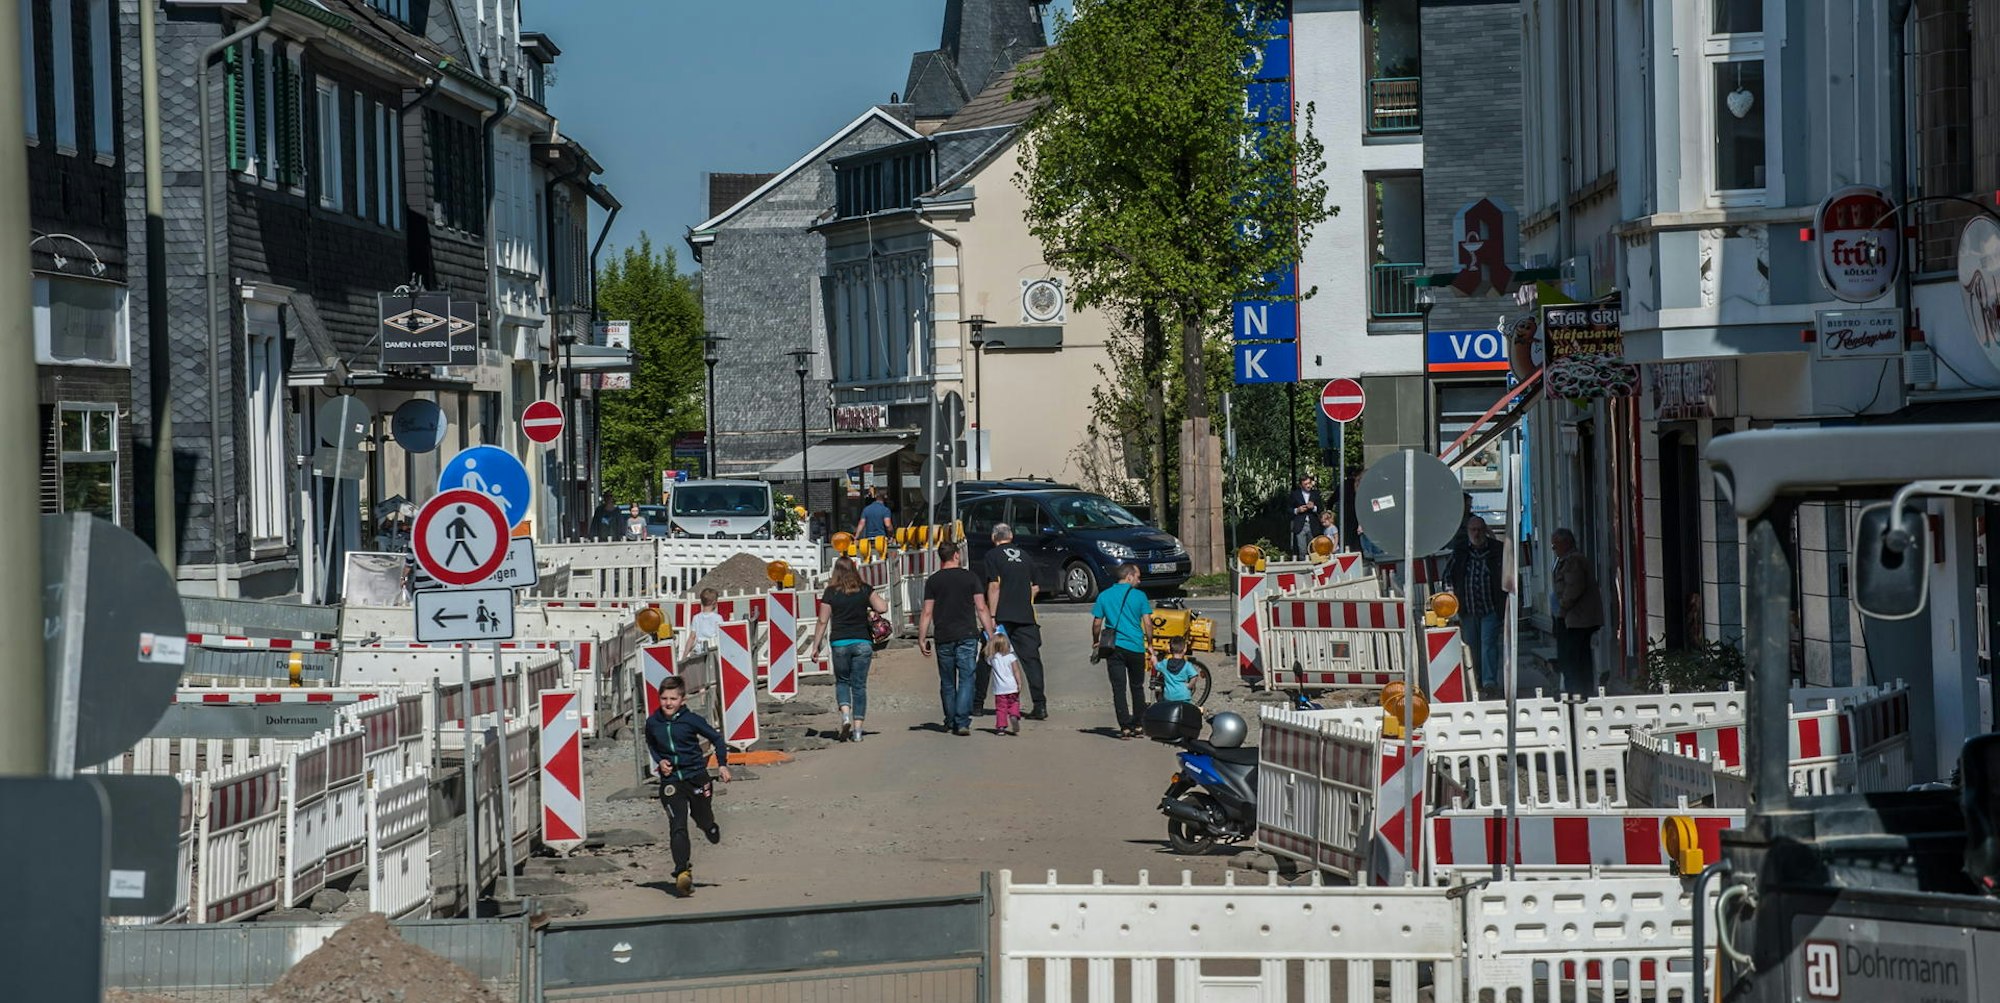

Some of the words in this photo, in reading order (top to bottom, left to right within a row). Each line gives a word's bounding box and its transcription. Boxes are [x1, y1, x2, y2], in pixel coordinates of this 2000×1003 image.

[1844, 268, 1878, 276] KÖLSCH
[1549, 310, 1587, 325] STAR
[1827, 320, 1860, 328] BISTRO
[384, 341, 411, 349] DAMEN
[276, 660, 324, 671] Domann
[266, 715, 318, 725] Dohrmann
[1846, 945, 1959, 987] Dohrmann
